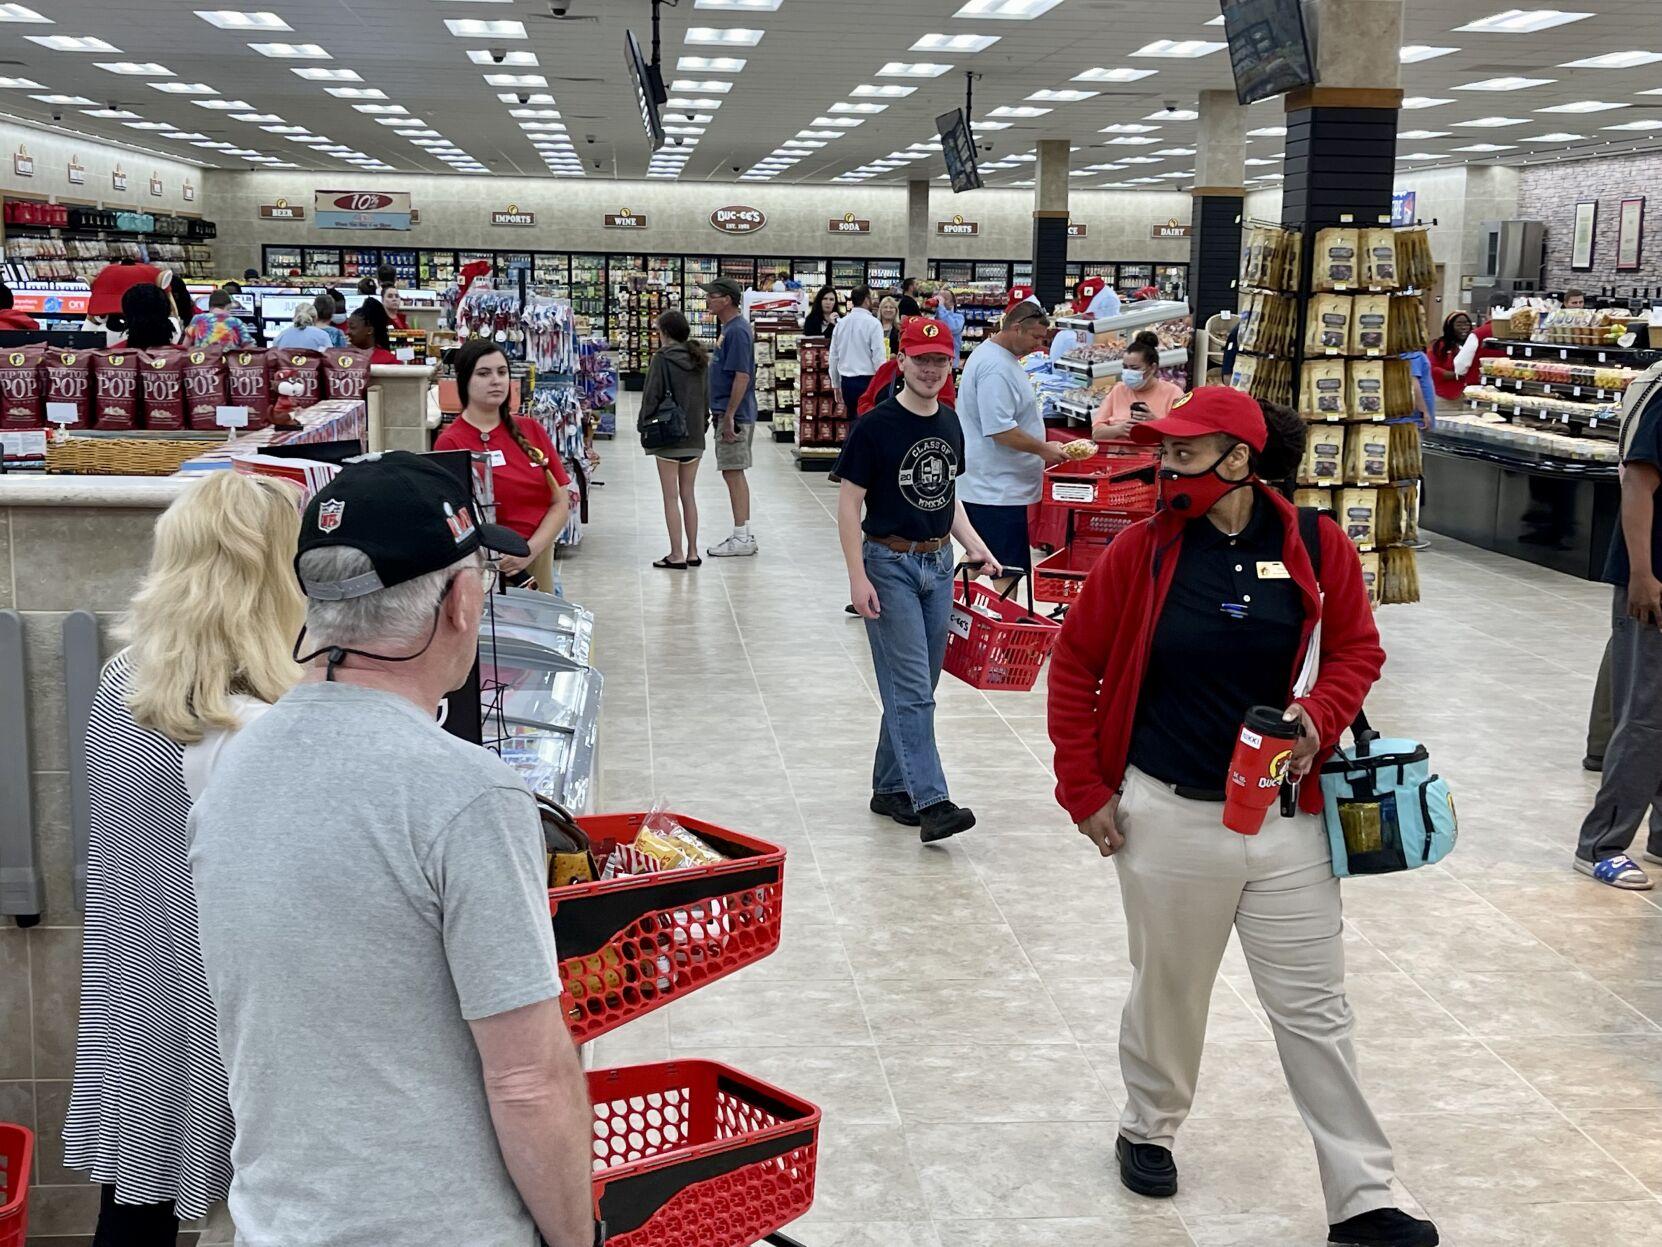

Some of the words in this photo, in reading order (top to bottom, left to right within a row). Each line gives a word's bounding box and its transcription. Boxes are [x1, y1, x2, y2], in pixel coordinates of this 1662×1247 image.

[272, 208, 293, 217] BEER
[495, 214, 531, 224] IMPORTS
[614, 217, 637, 226] WINE
[838, 222, 860, 231] SODA
[943, 225, 972, 234] SPORTS
[1067, 227, 1078, 235] CE
[1160, 228, 1185, 236] DAIRY
[49, 369, 66, 377] TIP
[68, 370, 88, 378] TOP
[159, 373, 179, 381] TOP
[246, 369, 263, 377] TOP
[2, 379, 37, 398] POP
[49, 377, 88, 397] POP
[97, 377, 136, 398] POP
[144, 381, 179, 400] POP
[184, 375, 219, 396] POP
[230, 376, 264, 396] POP
[329, 378, 365, 397] POP
[912, 441, 940, 458] CLASS
[940, 444, 951, 455] OF
[1258, 777, 1283, 788] BUC-
